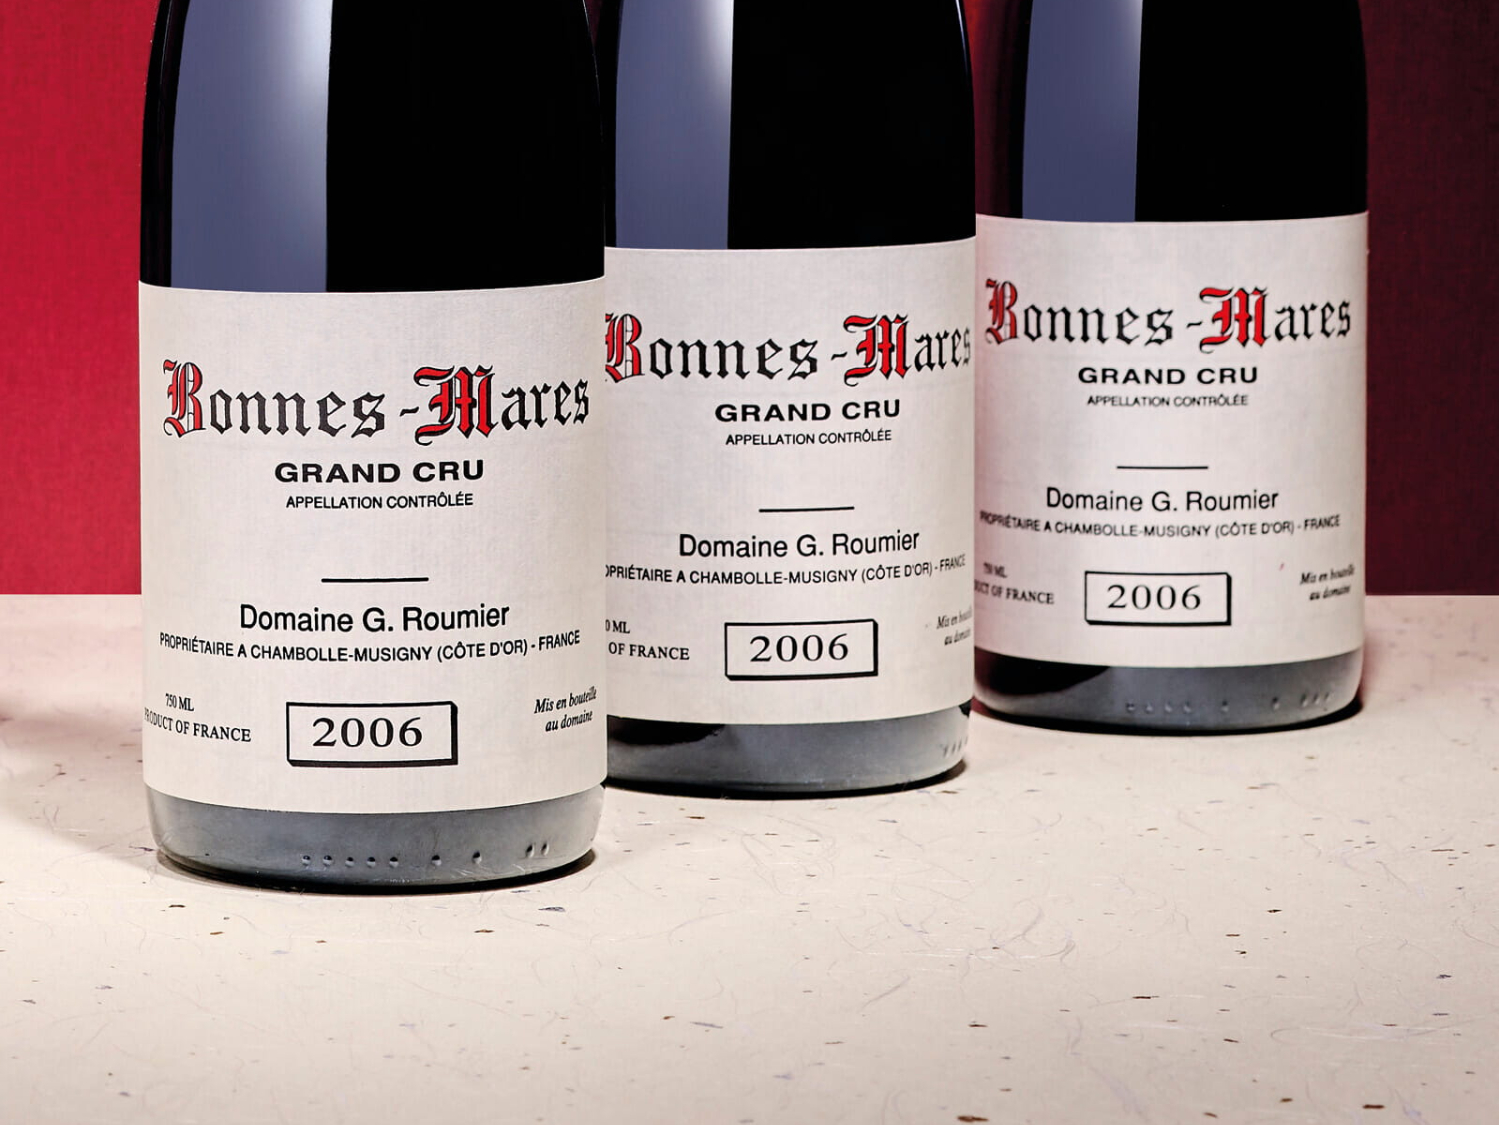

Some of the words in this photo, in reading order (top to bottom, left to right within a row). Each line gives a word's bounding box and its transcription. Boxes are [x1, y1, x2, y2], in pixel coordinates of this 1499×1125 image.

[1078, 366, 1186, 384] GRAND
[1196, 366, 1258, 384] CRU
[714, 402, 832, 422] GRAND
[842, 398, 900, 420] CRU
[1086, 396, 1170, 406] APPELLATION
[1174, 394, 1248, 408] CONTRÔLÉE
[726, 434, 816, 446] APPELLATION
[818, 428, 892, 444] CONTRÔLÉE
[274, 462, 400, 484] GRAND
[412, 458, 484, 482] CRU
[286, 496, 382, 510] APPELLATION
[386, 490, 474, 510] CONTRÔLÉE
[1046, 486, 1144, 512] Domaine
[1152, 490, 1178, 512] G.
[1186, 488, 1280, 512] Roumier
[1054, 520, 1212, 538] CHAMBOLLE-MUSIGNY
[1214, 522, 1258, 538] (CÔTE
[1304, 514, 1340, 530] FRANCE
[680, 534, 788, 558] Domaine
[796, 534, 824, 558] G.
[832, 528, 920, 556] Roumier
[690, 568, 858, 586] CHAMBOLLE-MUSIGNY
[862, 564, 900, 584] (CÔTE
[904, 562, 932, 578] D'OR)
[940, 554, 966, 572] FRANCE
[1006, 588, 1054, 604] FRANCE
[1108, 584, 1200, 610] 2006
[240, 604, 354, 632] Domaine
[362, 606, 394, 632] G.
[402, 602, 510, 632] Roumier
[612, 620, 630, 634] ML
[160, 632, 234, 656] PROPRIÉTAIRE
[250, 644, 432, 662] CHAMBOLLE-MUSIGNY
[436, 640, 486, 664] (CÔTE
[490, 638, 528, 656] D'OR)
[538, 630, 580, 652] FRANCE
[608, 642, 626, 656] OF
[630, 644, 690, 660] FRANCE
[750, 634, 848, 662] 2006
[166, 692, 178, 708] 750
[178, 696, 194, 712] ML
[534, 698, 554, 714] Mis
[176, 720, 190, 734] OF
[192, 722, 252, 742] FRANCE
[312, 716, 422, 748] 2006
[544, 720, 558, 732] au
[560, 710, 592, 730] domaine
